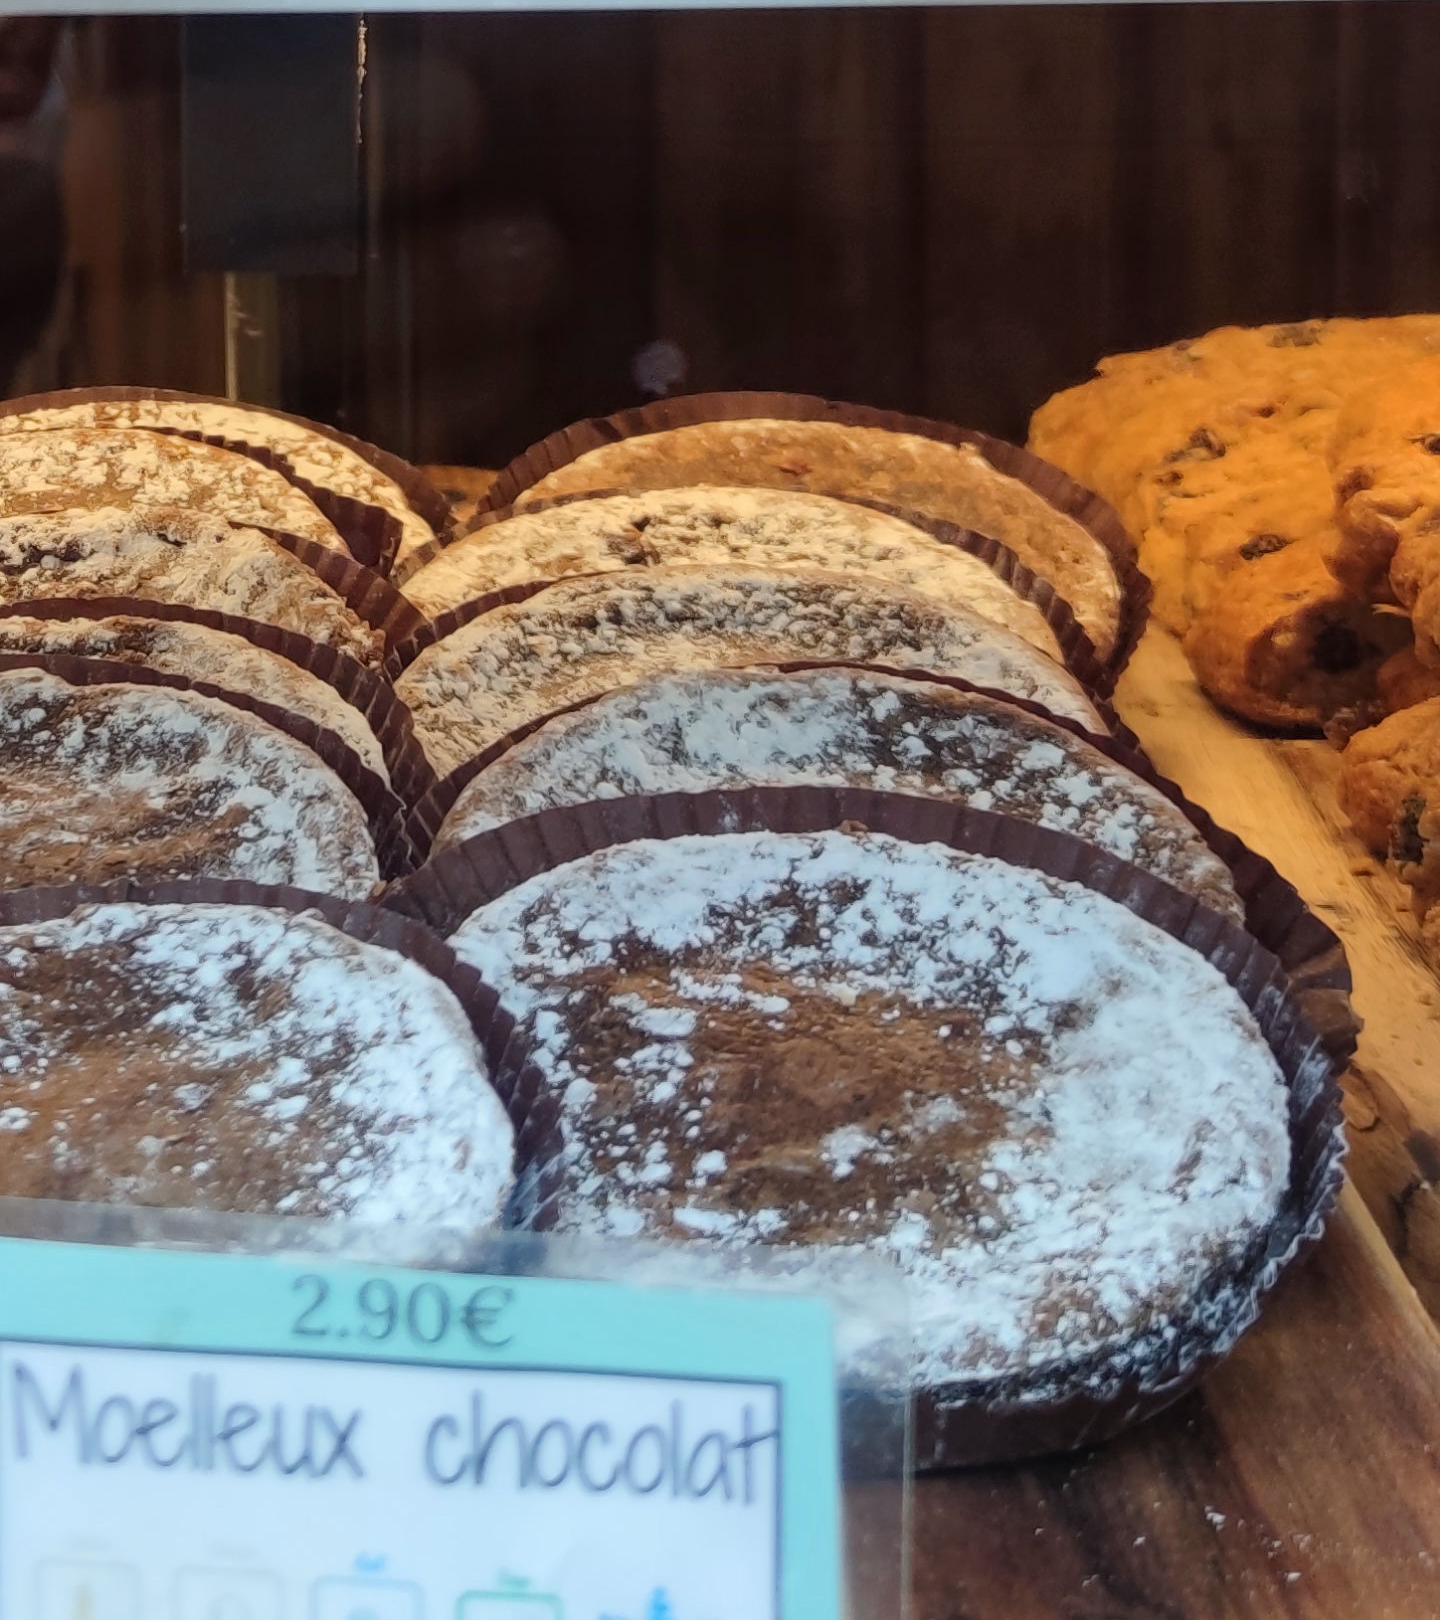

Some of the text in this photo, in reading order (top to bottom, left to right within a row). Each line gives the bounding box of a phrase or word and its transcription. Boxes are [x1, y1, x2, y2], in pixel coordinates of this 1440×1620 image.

[290, 1273, 517, 1349] 2.90€
[10, 1357, 778, 1507] Moelleux chocolat
